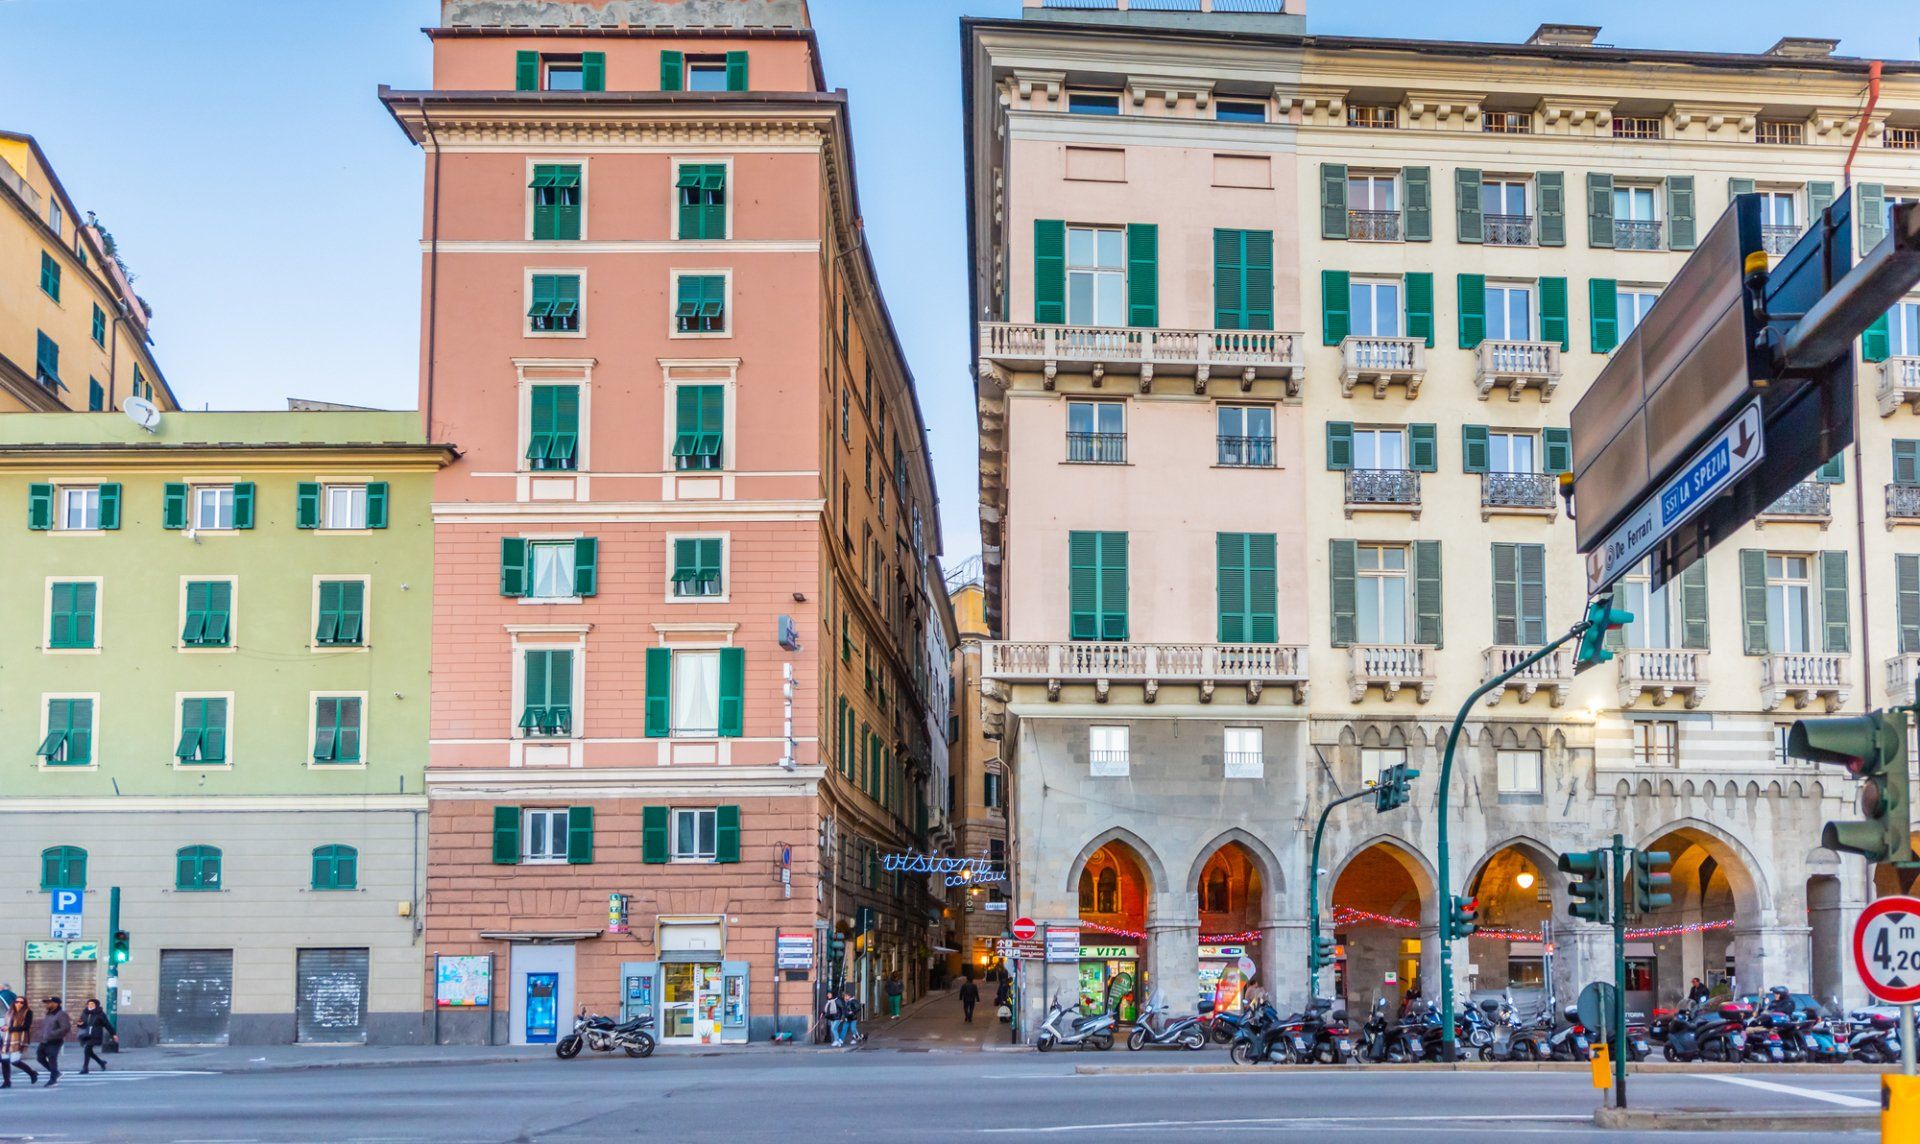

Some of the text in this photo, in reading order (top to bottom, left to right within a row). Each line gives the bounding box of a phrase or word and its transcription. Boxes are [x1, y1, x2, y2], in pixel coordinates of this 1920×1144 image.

[1680, 481, 1690, 504] LA
[1694, 448, 1727, 491] SPEZIA
[1616, 513, 1652, 559] De Ferrari
[883, 846, 992, 874] visioni
[58, 891, 77, 911] P
[1899, 926, 1915, 939] m
[1096, 947, 1127, 956] VITA
